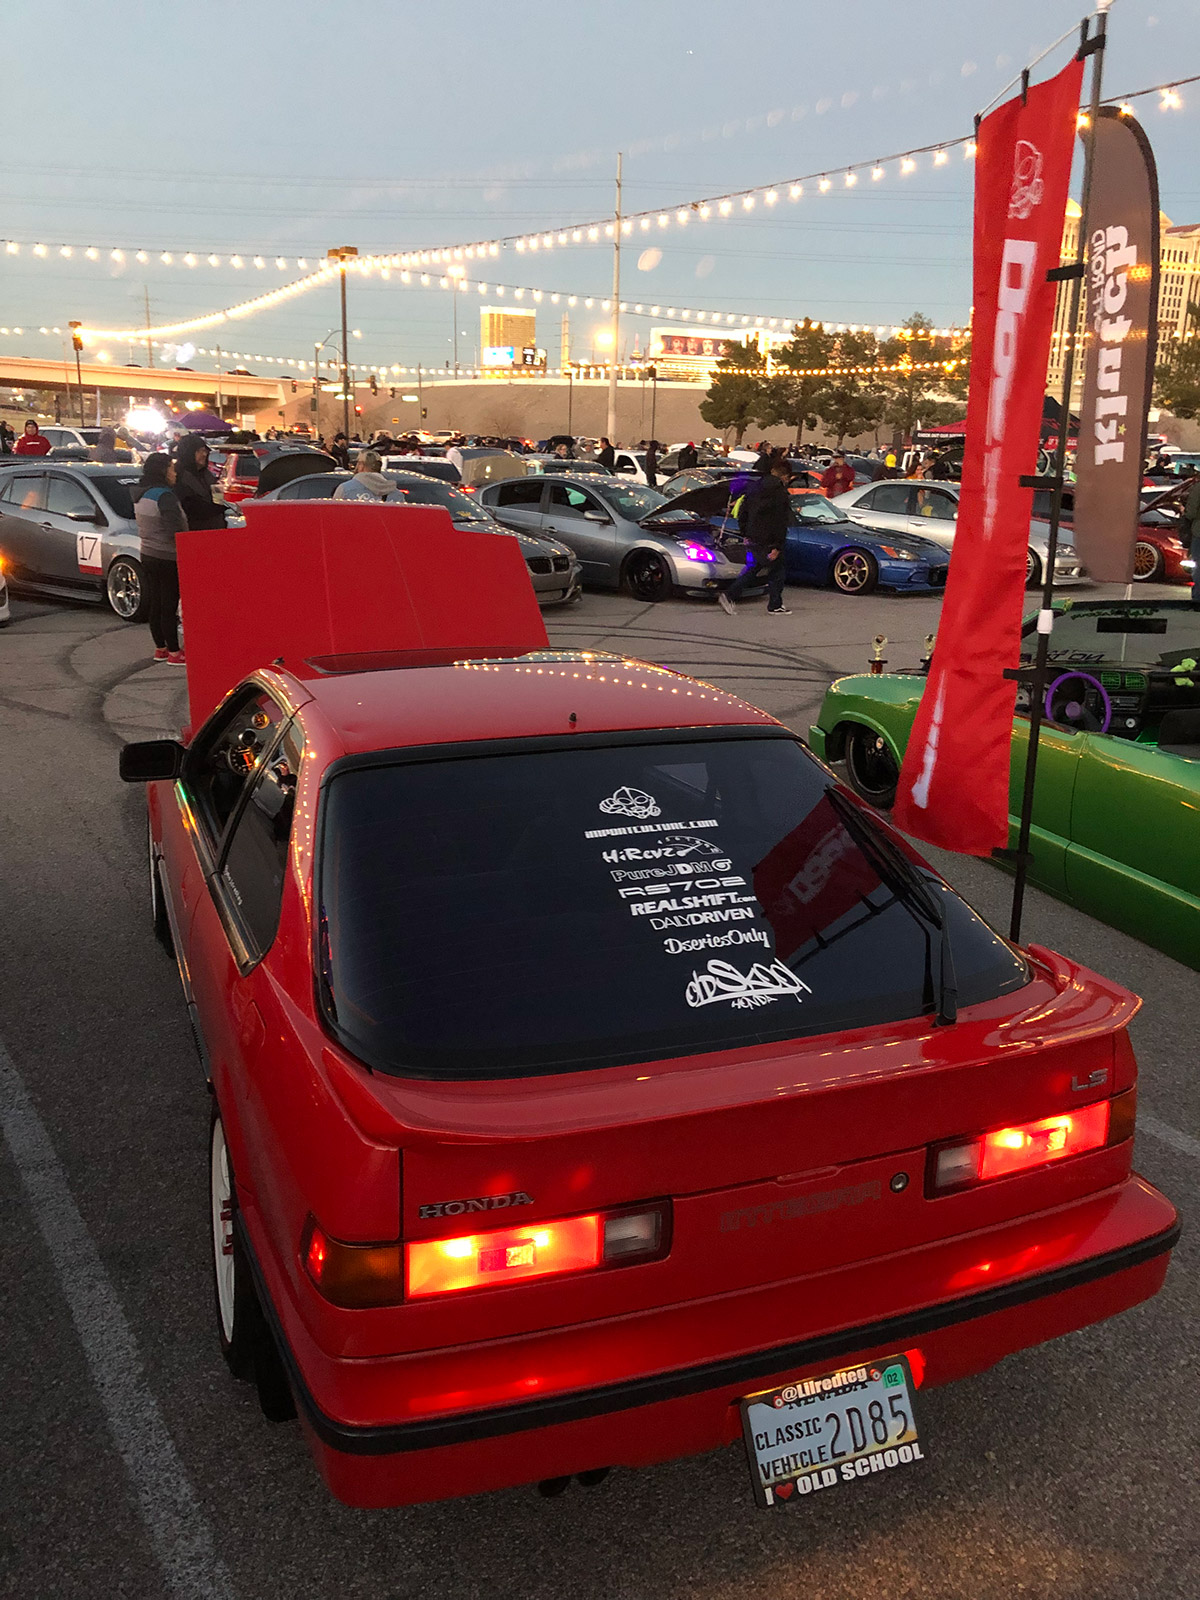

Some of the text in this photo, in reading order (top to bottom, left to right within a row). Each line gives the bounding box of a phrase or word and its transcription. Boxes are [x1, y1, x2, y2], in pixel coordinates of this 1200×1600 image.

[79, 535, 98, 561] 17
[610, 861, 713, 882] PureJDM
[618, 876, 747, 898] RS702
[1071, 1068, 1108, 1091] LS
[419, 1192, 534, 1219] HONDA
[887, 1372, 898, 1384] 02
[755, 1417, 822, 1450] CLASSIC
[825, 1394, 908, 1460] 2D85
[760, 1445, 829, 1480] VEHICLE
[764, 1443, 925, 1506] I OLD SCHOOL
